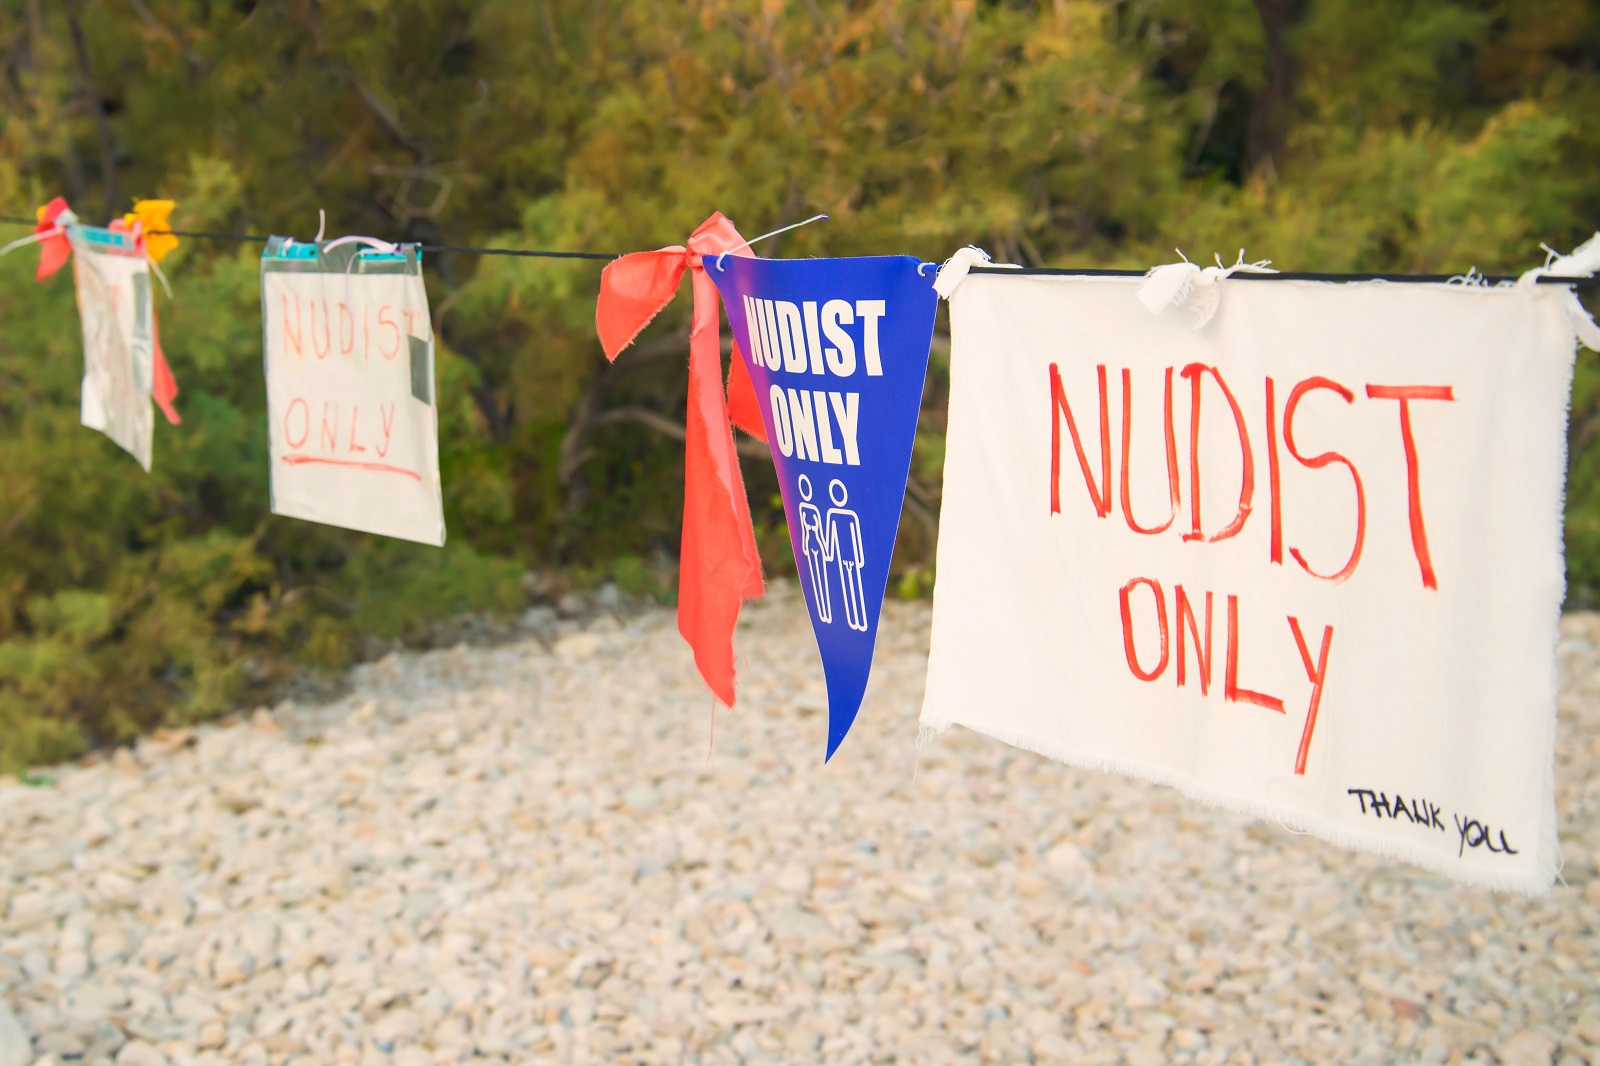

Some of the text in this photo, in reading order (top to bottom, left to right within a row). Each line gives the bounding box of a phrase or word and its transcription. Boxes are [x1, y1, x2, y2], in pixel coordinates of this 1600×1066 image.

[742, 294, 886, 378] NUDIST
[284, 397, 396, 458] ONLY
[769, 384, 861, 466] ONLY
[1049, 362, 1455, 592] NUDIST
[1118, 576, 1334, 776] ONLY
[1347, 788, 1519, 858] THANK YOU
